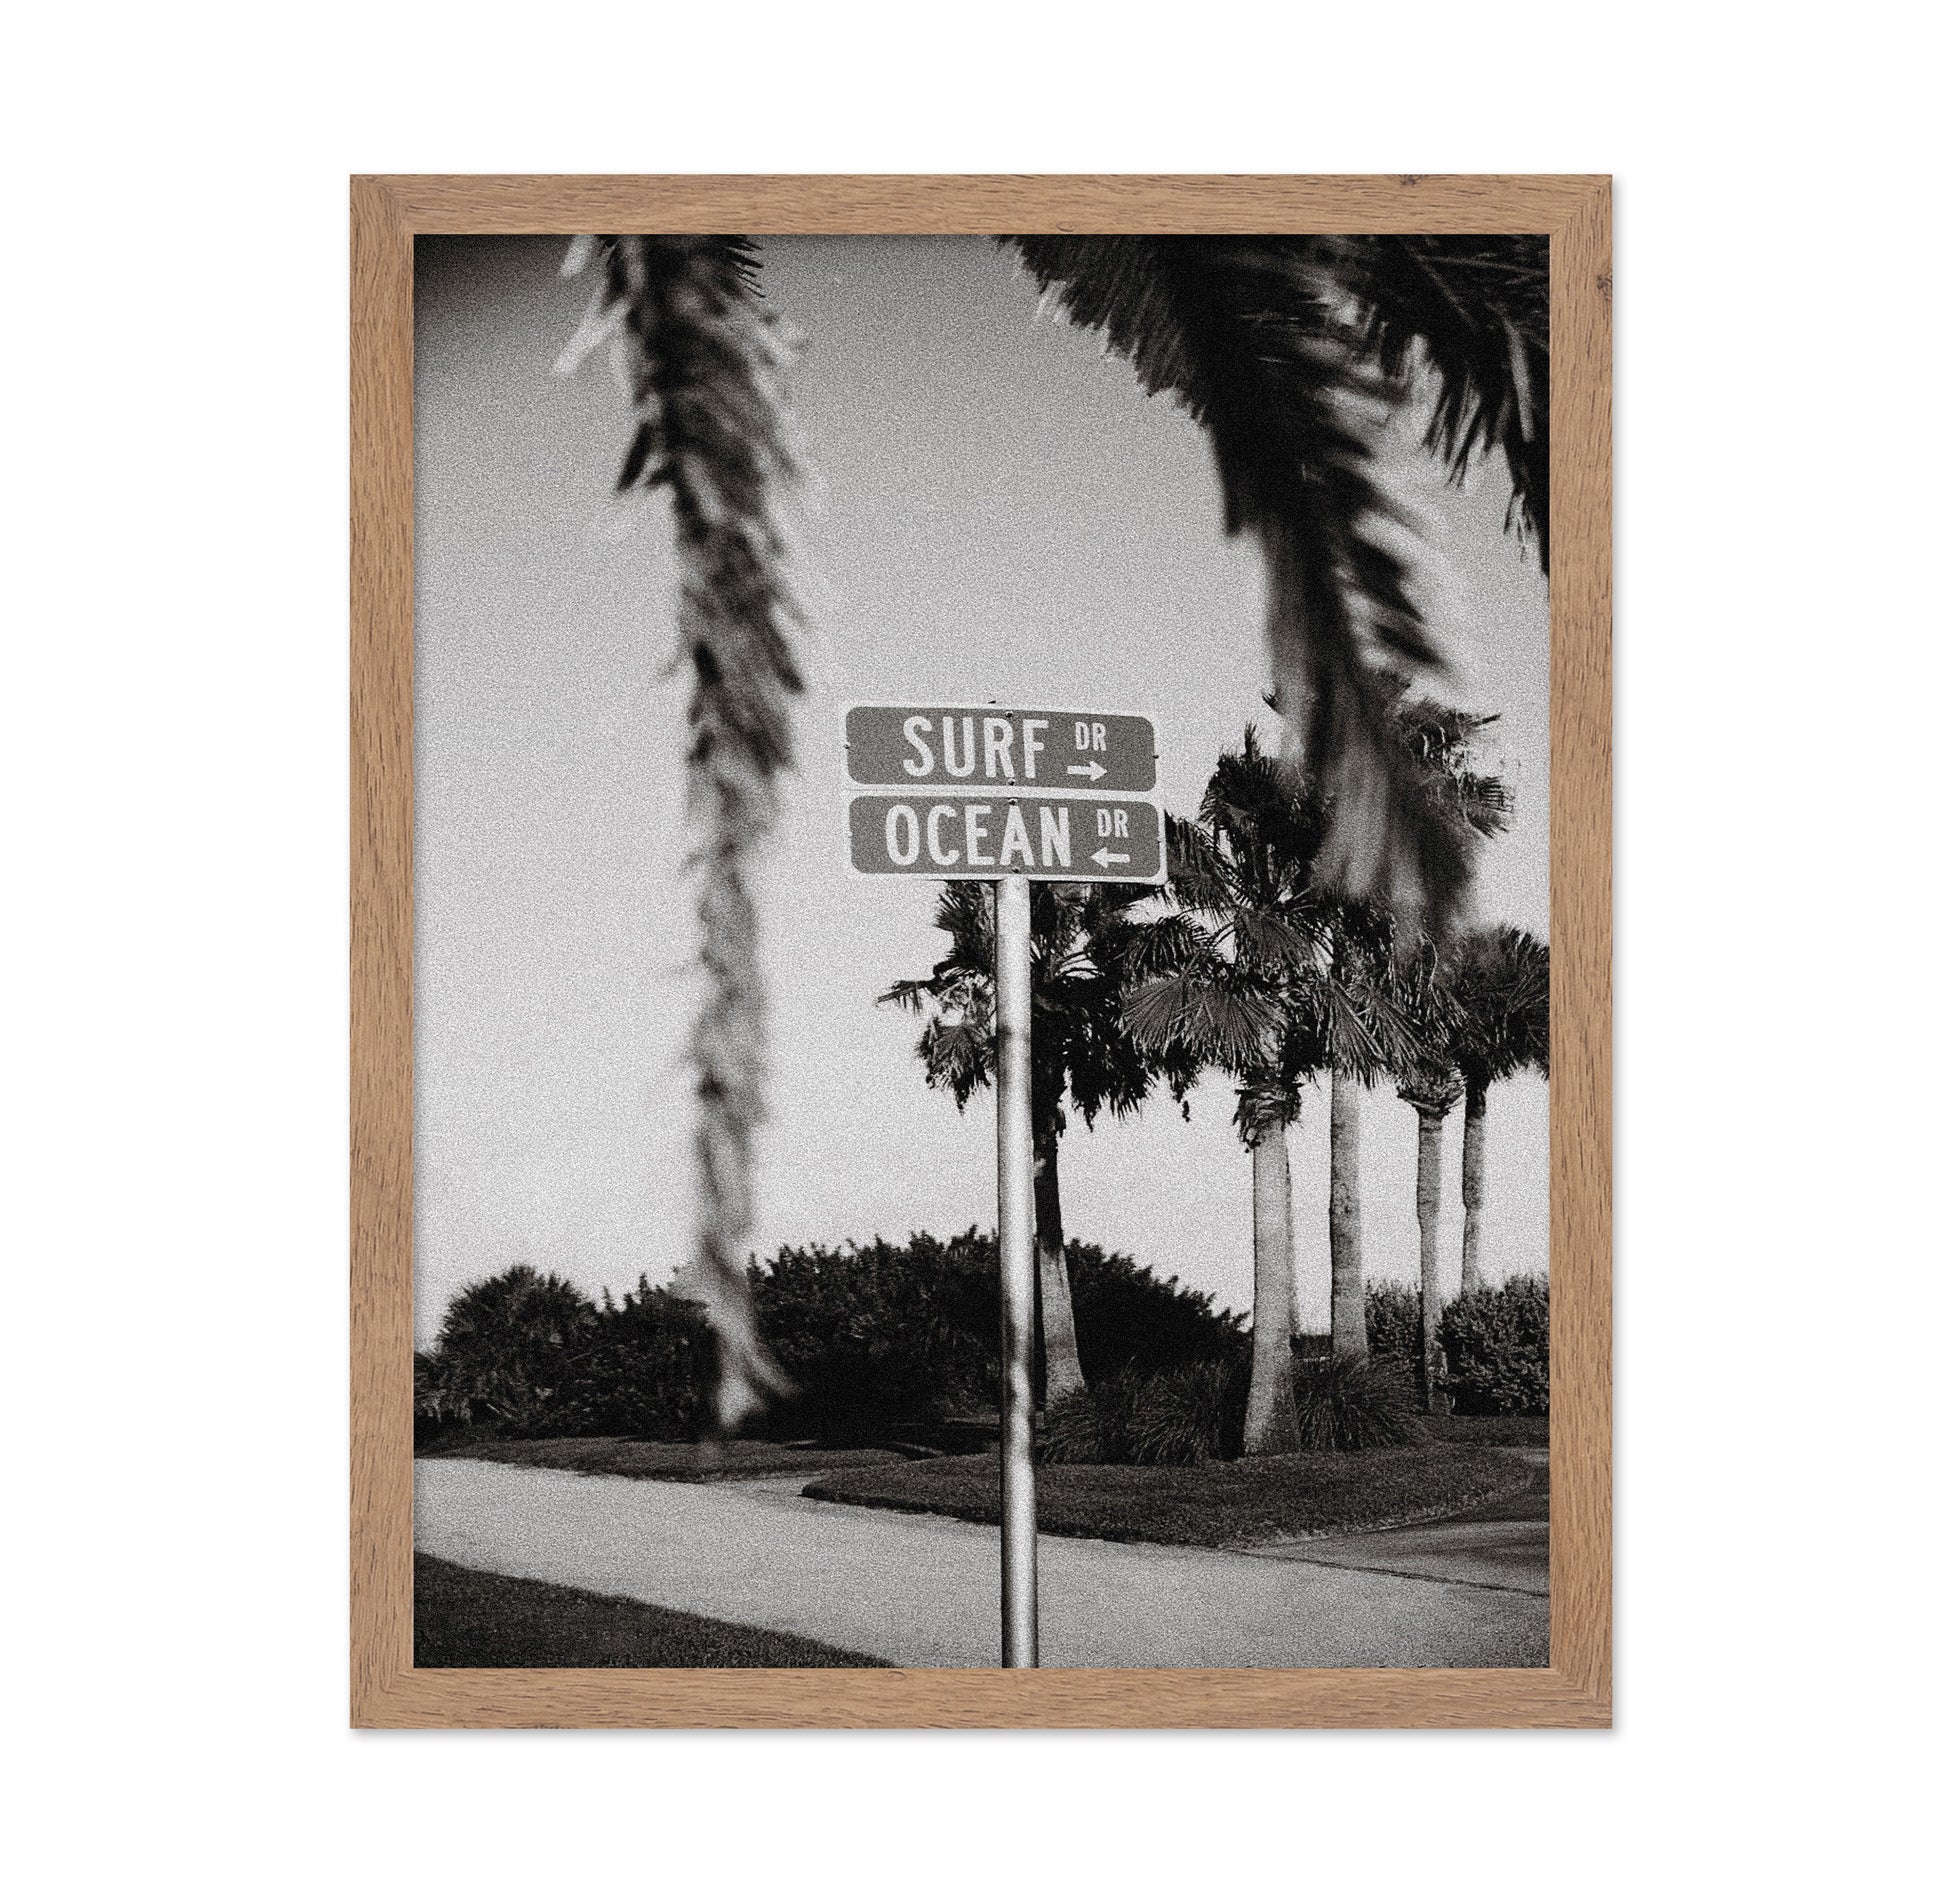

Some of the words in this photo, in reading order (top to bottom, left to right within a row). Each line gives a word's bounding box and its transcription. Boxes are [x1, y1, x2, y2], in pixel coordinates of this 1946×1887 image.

[902, 716, 1049, 778] SURF
[1074, 722, 1107, 751] DR
[885, 804, 1072, 867] OCEAN
[1096, 808, 1129, 838] DR
